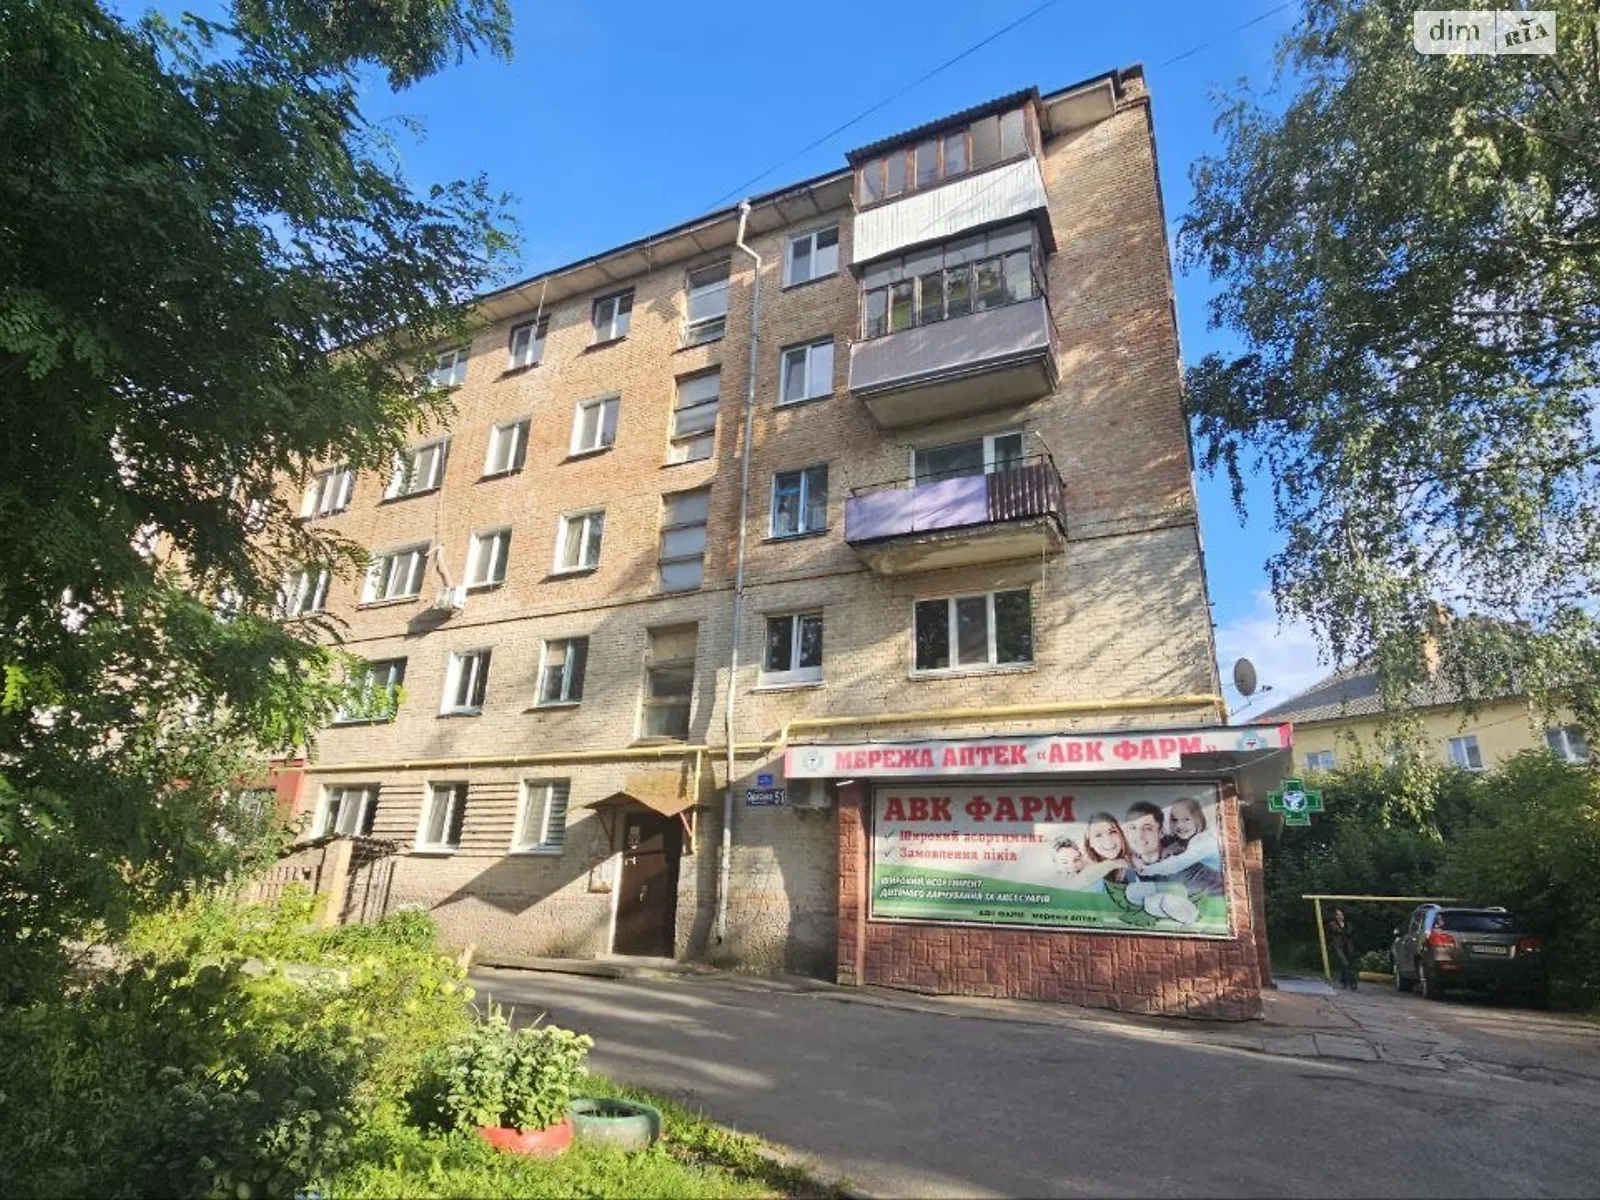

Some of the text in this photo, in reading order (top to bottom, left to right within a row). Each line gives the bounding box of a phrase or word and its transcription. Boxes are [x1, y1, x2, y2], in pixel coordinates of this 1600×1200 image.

[835, 748, 934, 770] МЕРЕЖА
[942, 745, 1027, 768] АПТЕК
[1037, 741, 1104, 764] «АВК
[883, 795, 1075, 822] АВК ФАРМ
[900, 829, 960, 843] Широкий
[900, 847, 1018, 861] Замовлення ліків
